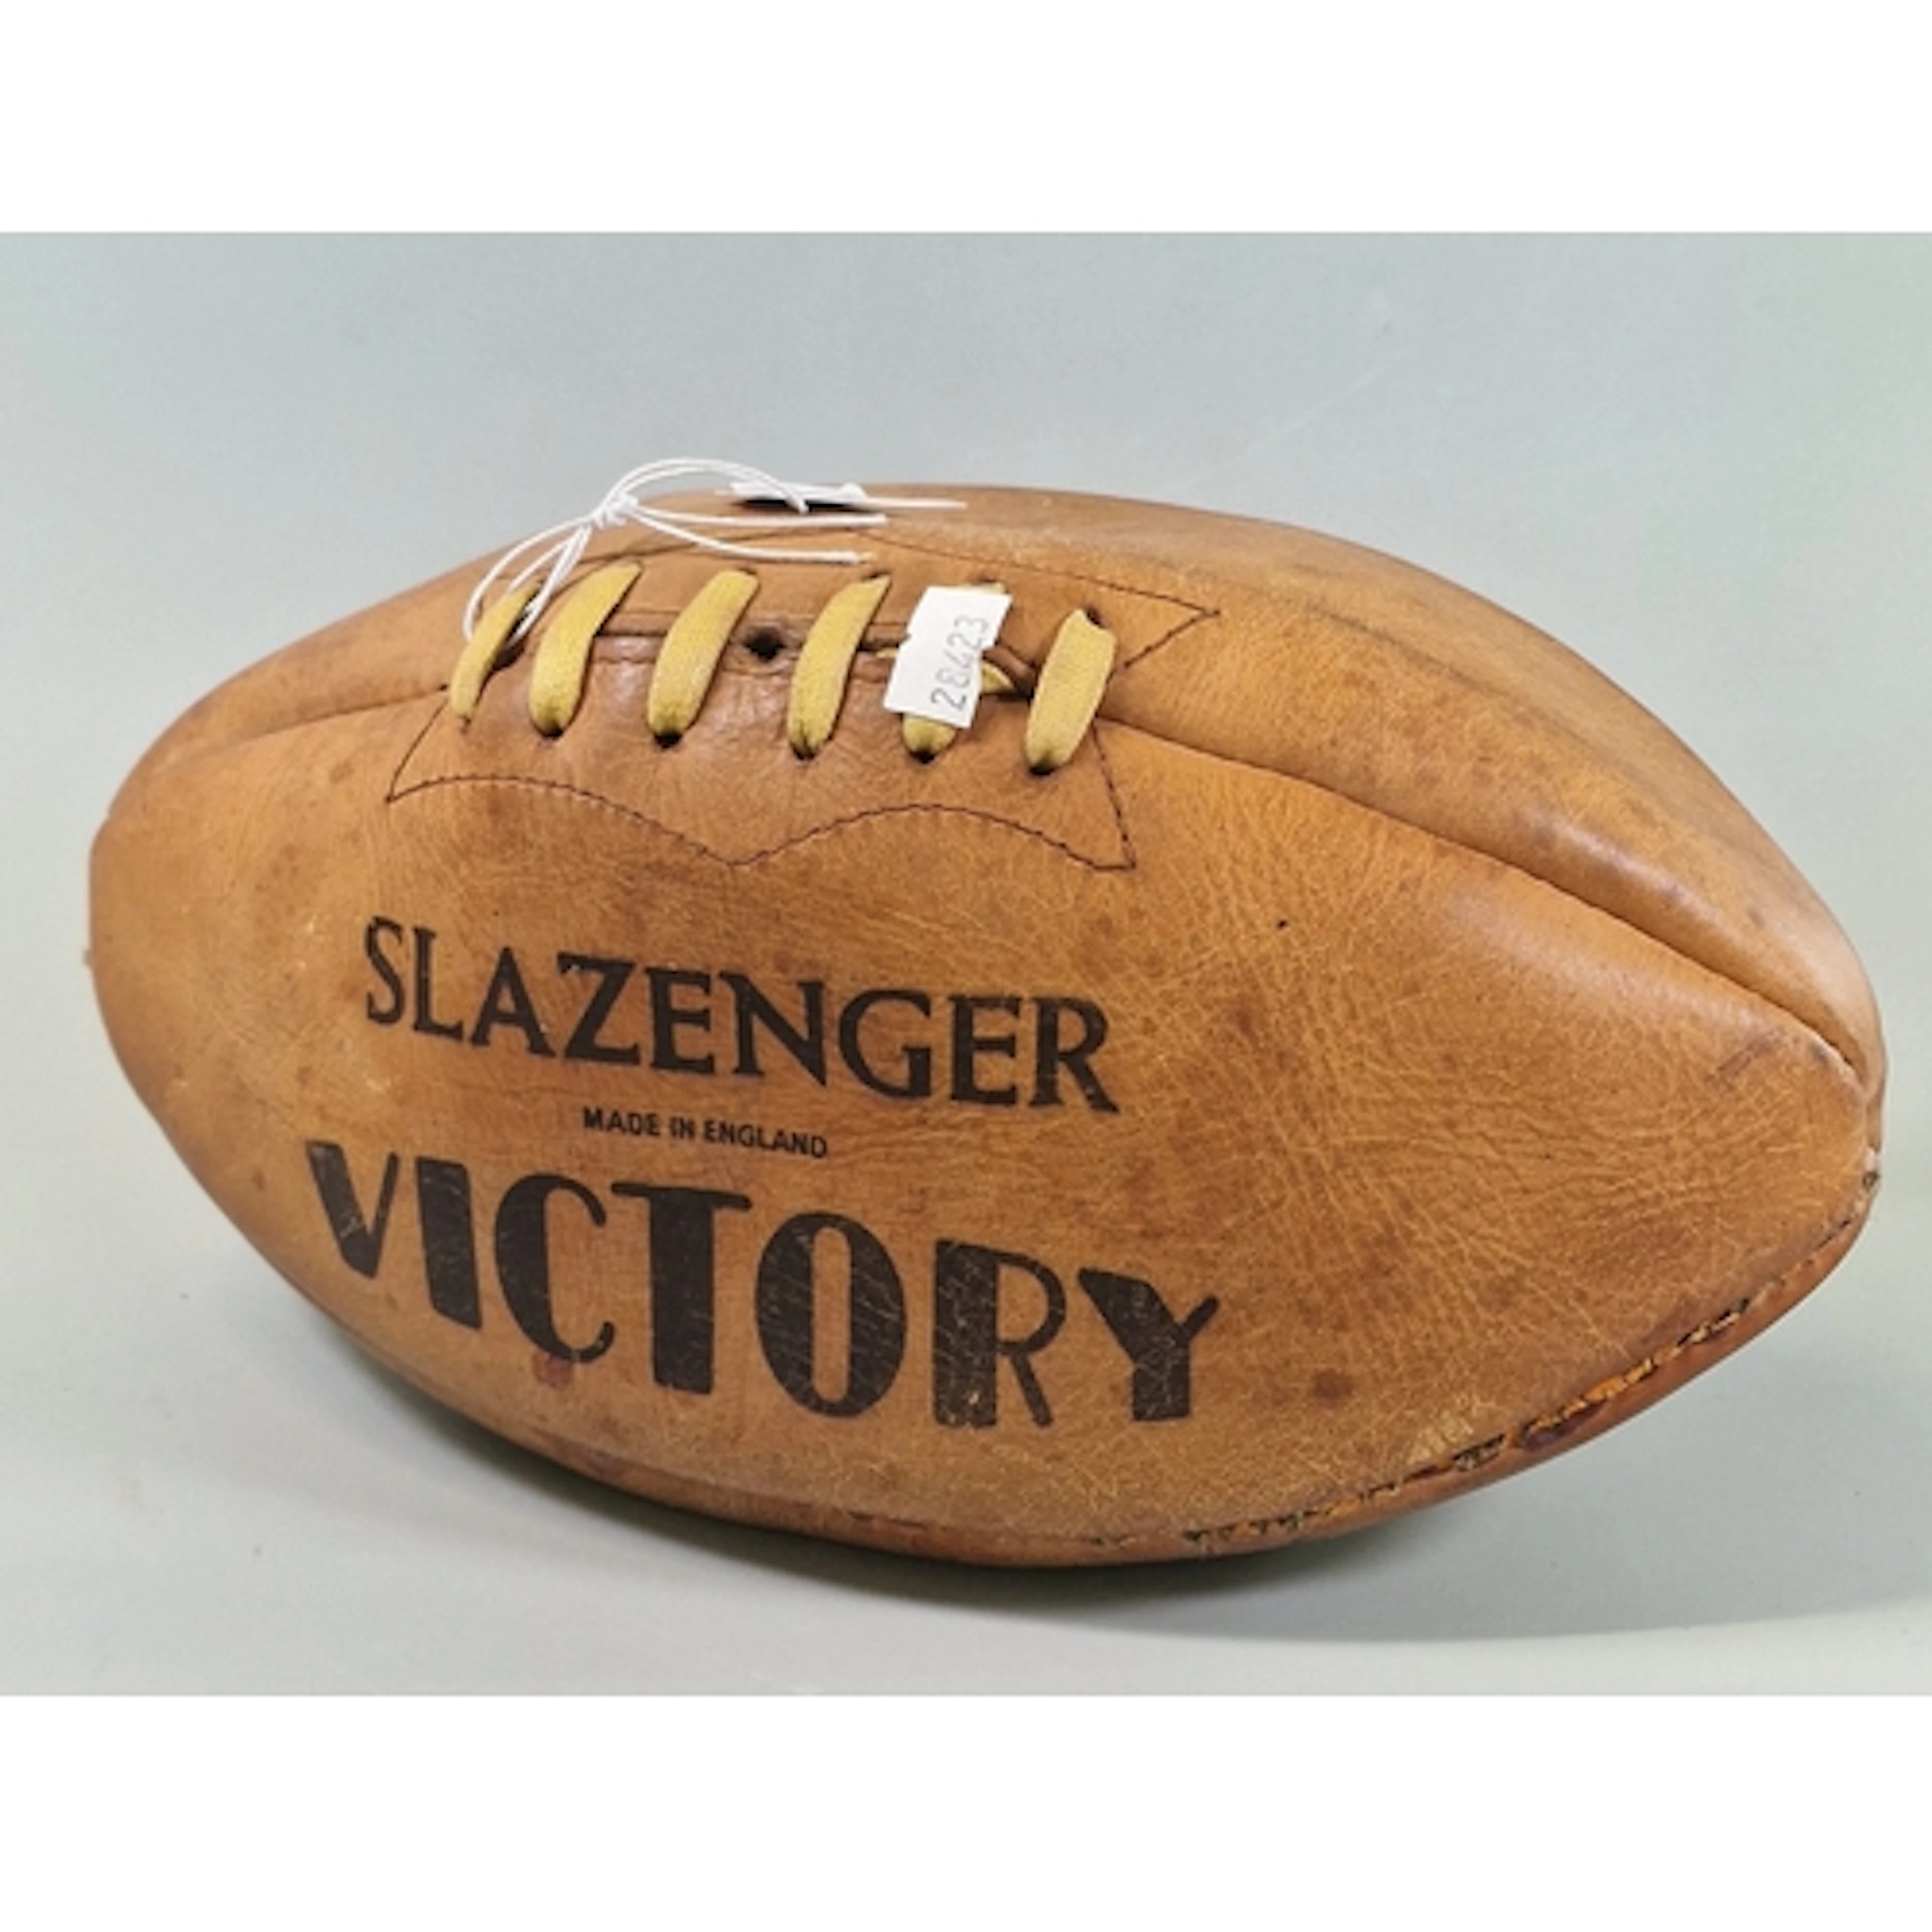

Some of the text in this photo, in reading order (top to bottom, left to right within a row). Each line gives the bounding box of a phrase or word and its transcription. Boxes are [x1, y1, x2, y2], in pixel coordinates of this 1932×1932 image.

[930, 614, 990, 711] 28423
[364, 916, 1120, 1114] SLAZENGER
[583, 1106, 828, 1158] MADE IN ENGLAND
[306, 1140, 1220, 1429] VICTORY
